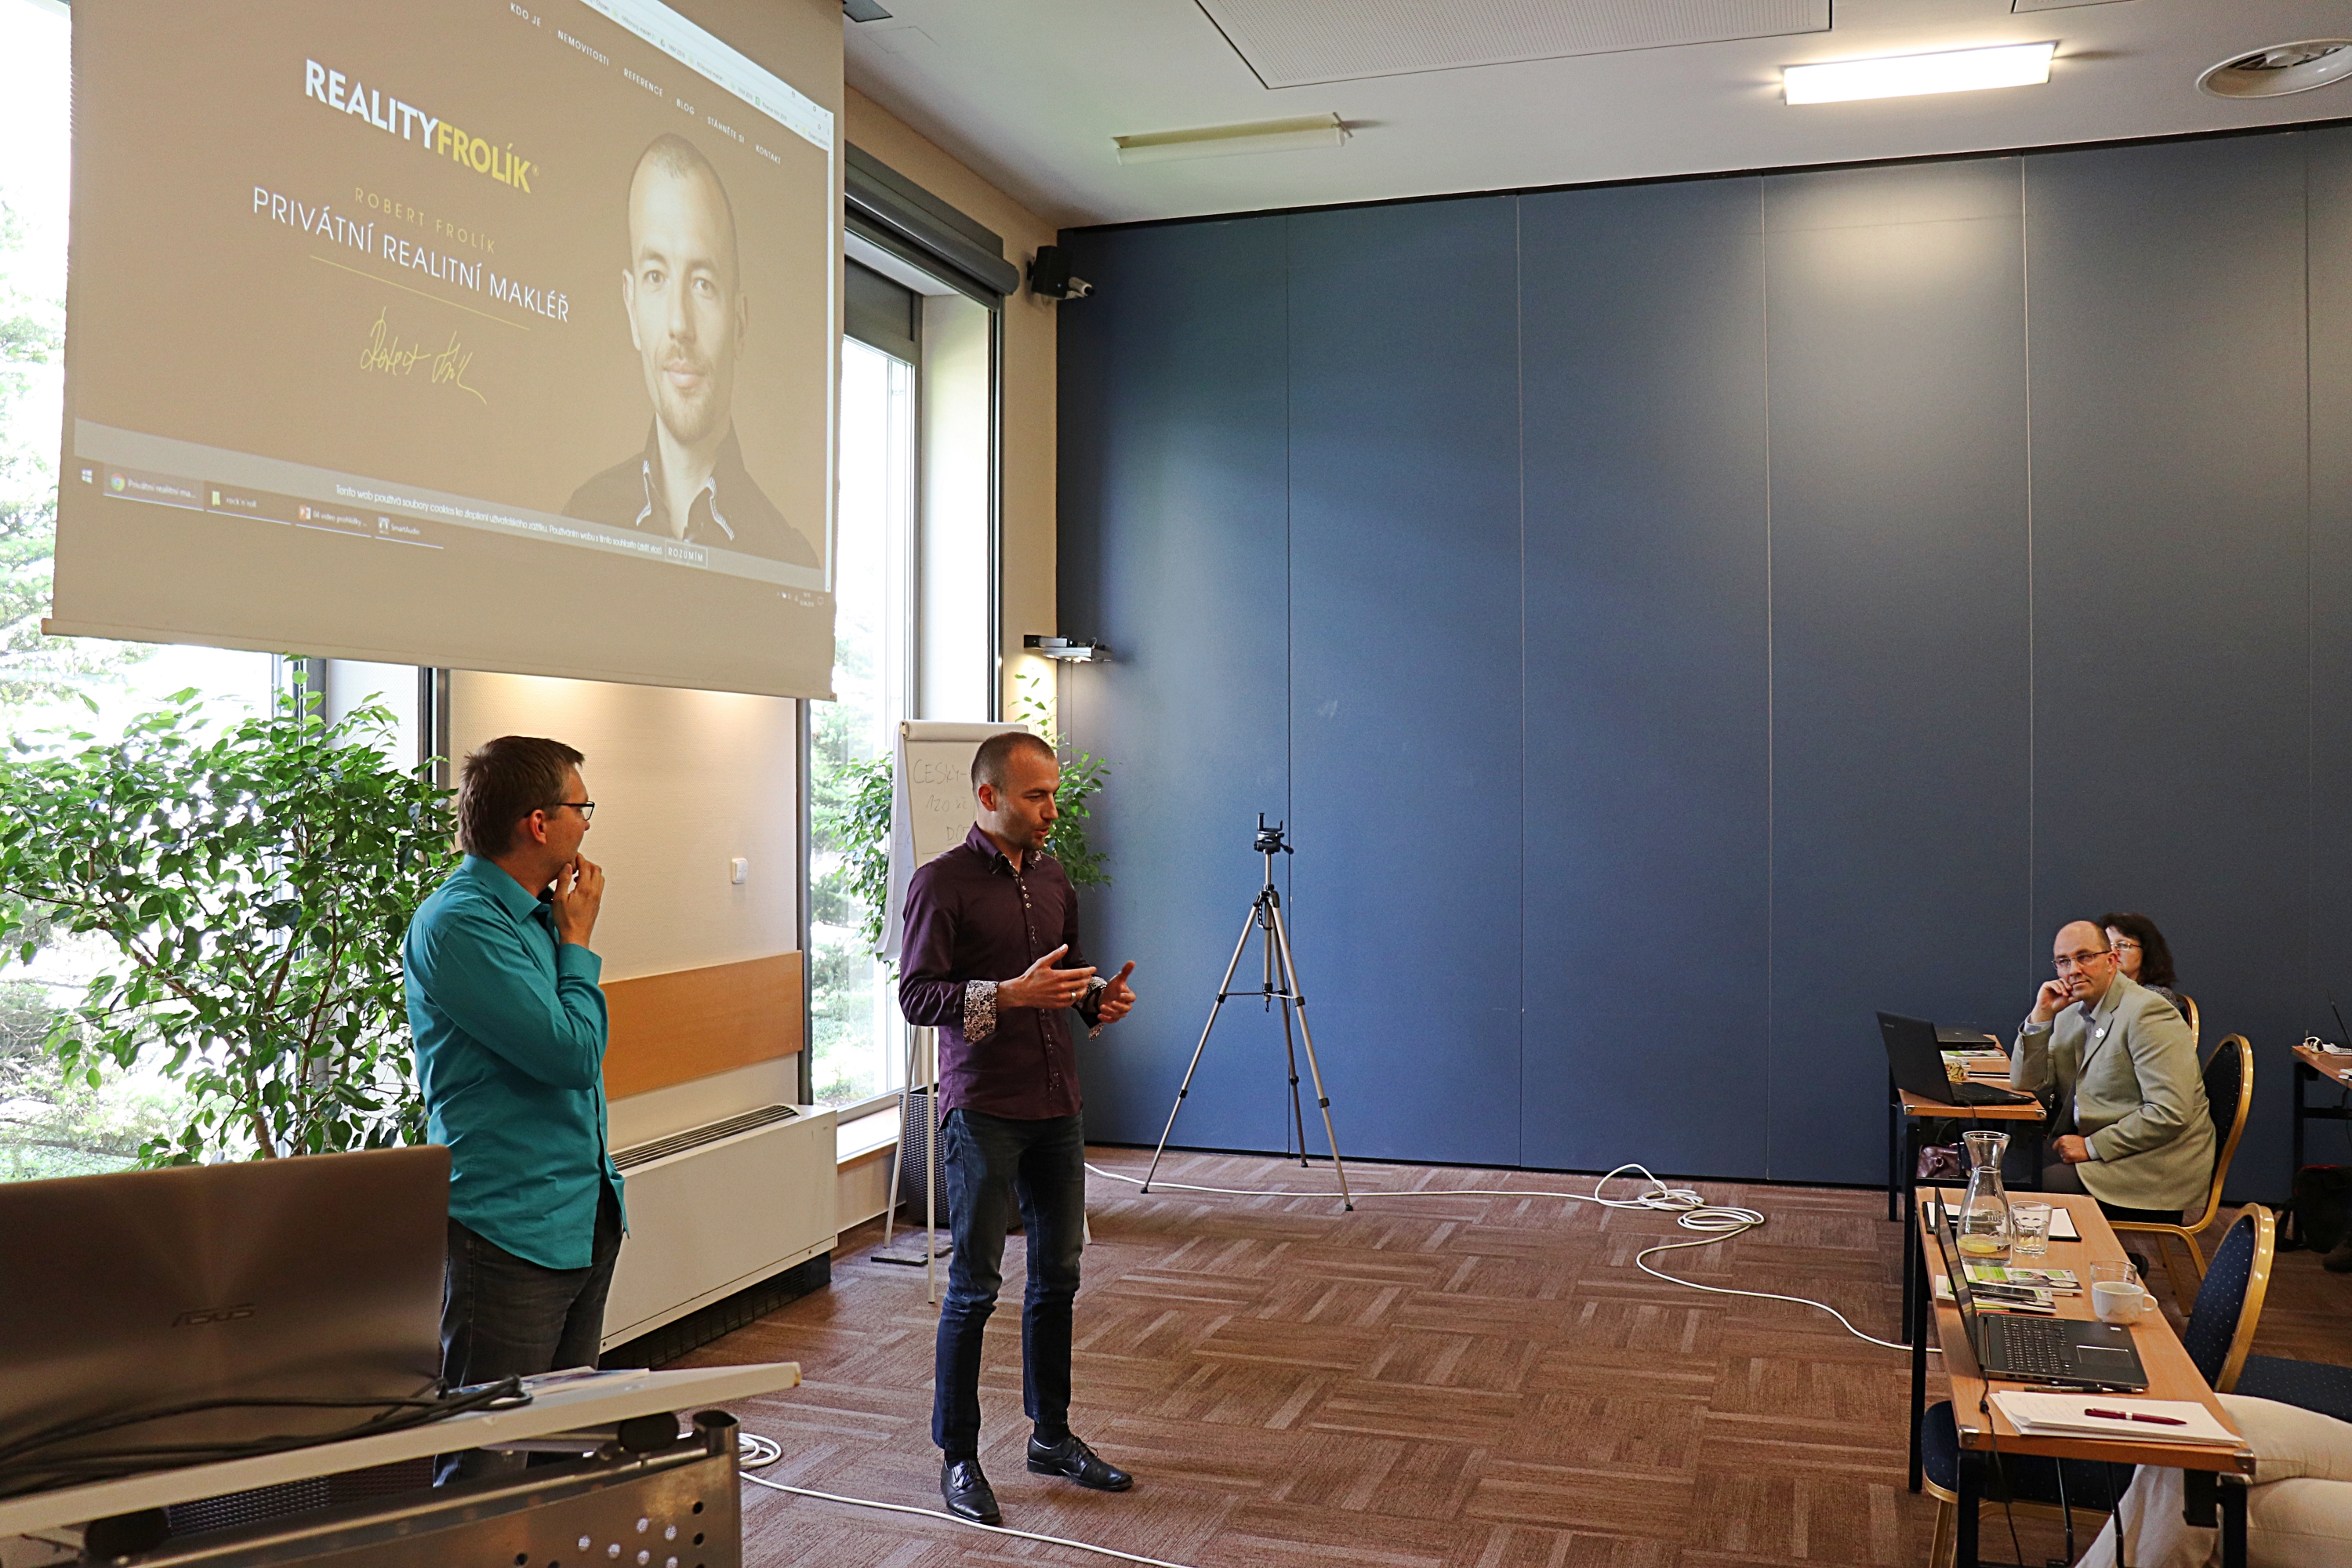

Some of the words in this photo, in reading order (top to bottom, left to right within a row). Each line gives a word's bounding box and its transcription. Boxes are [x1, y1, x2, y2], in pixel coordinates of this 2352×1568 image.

[510, 2, 529, 20] KDO
[532, 16, 542, 27] JE
[557, 30, 609, 67] NEMOVITOSTI
[623, 67, 663, 97] REFERENCE
[676, 98, 695, 115] BLOG
[755, 144, 781, 165] KONTAKT
[355, 187, 425, 226] ROBERT
[436, 219, 495, 254] FROLÍK
[253, 186, 375, 253] PRIVÁTNÍ
[383, 234, 483, 292] REALITNÍ
[489, 273, 570, 323] MAKLÉŘ
[336, 484, 356, 497] Tento
[357, 490, 373, 501] web
[402, 499, 429, 512] soubory
[430, 504, 454, 516] cookies
[668, 546, 703, 562] ROZUMÍM
[172, 1303, 255, 1328] ASUS
